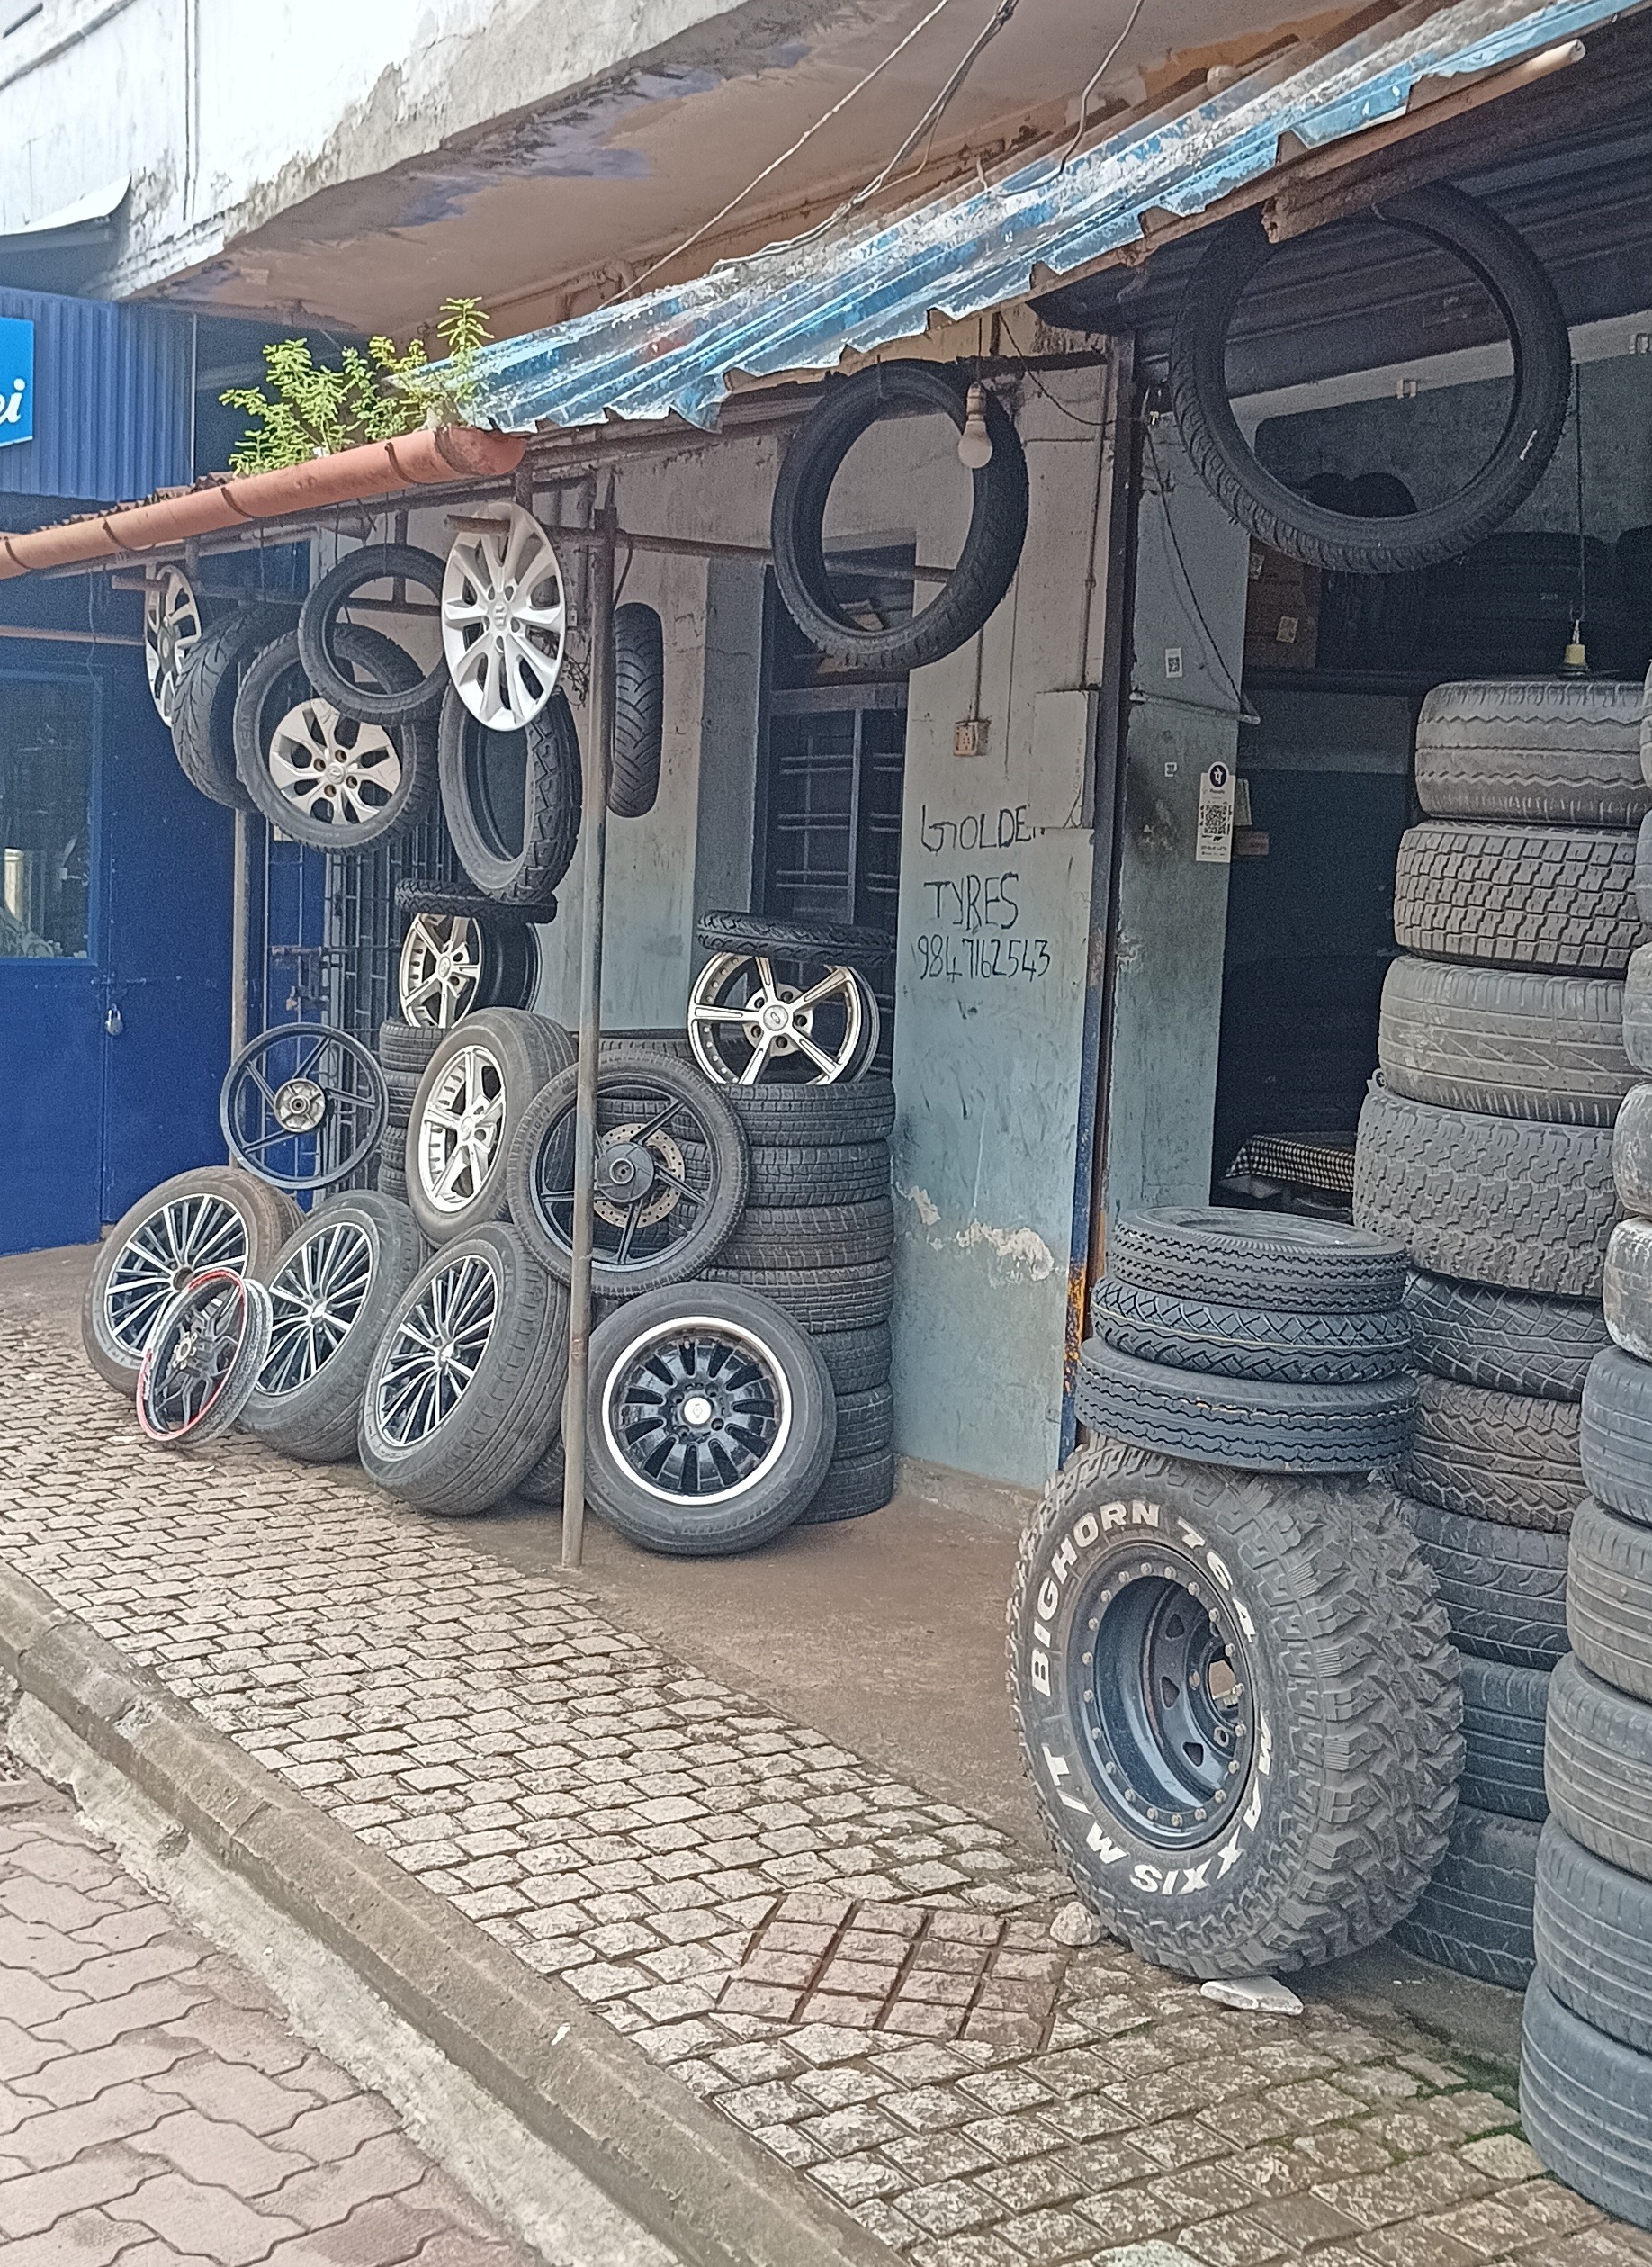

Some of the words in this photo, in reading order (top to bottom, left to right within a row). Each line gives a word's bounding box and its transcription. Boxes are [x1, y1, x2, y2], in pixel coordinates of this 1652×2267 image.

[924, 871, 1019, 931] TYRES
[1031, 1499, 1160, 1696] BIGHORN
[1129, 1708, 1272, 1895] MAXXIS
